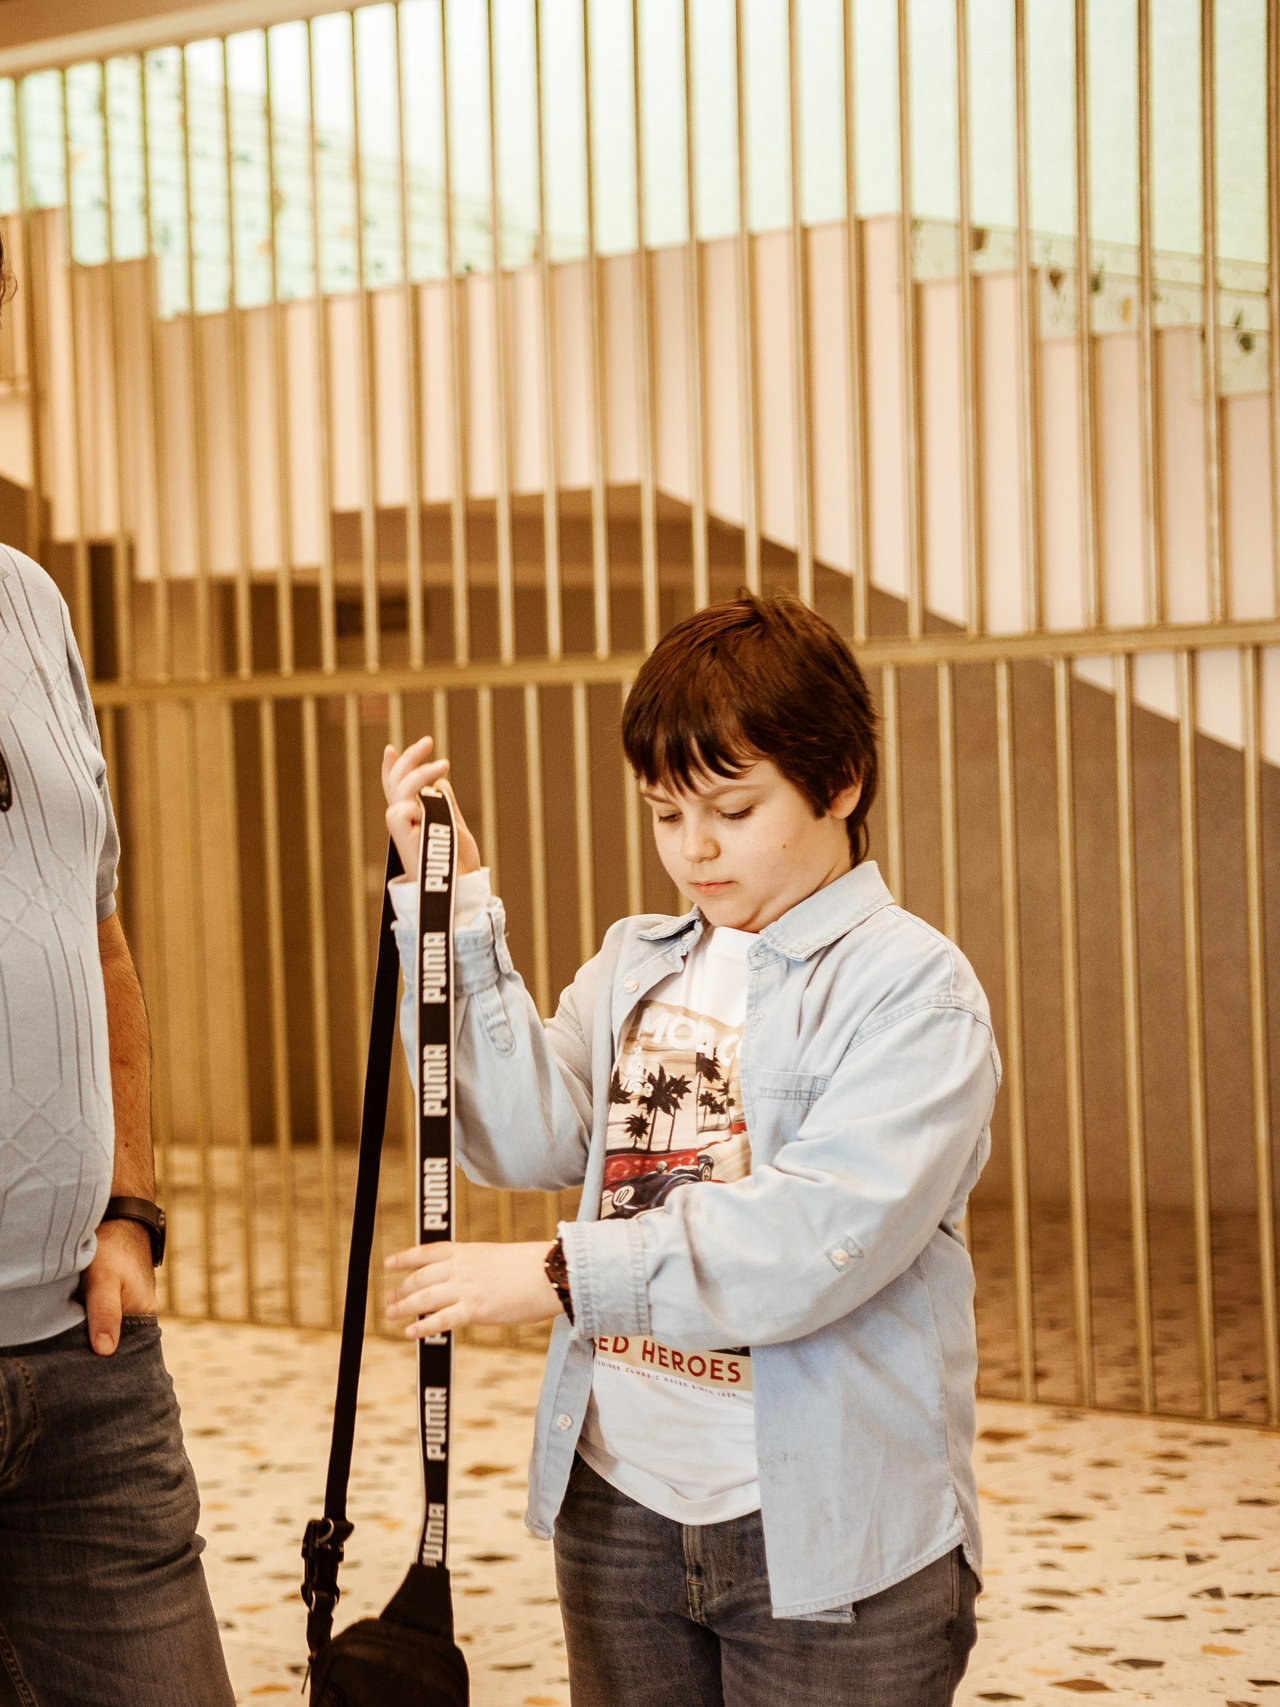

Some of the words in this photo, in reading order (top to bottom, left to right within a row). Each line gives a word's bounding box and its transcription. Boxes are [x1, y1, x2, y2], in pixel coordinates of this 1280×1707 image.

[425, 823, 451, 892] PUMA
[423, 932, 446, 1004] PUMA
[423, 1044, 448, 1117] PUMA
[423, 1157, 448, 1231] PUMA
[594, 1336, 630, 1354] ED
[642, 1339, 741, 1383] HEROES
[625, 1367, 660, 1381] CLASSIC
[425, 1387, 447, 1462] PUMA
